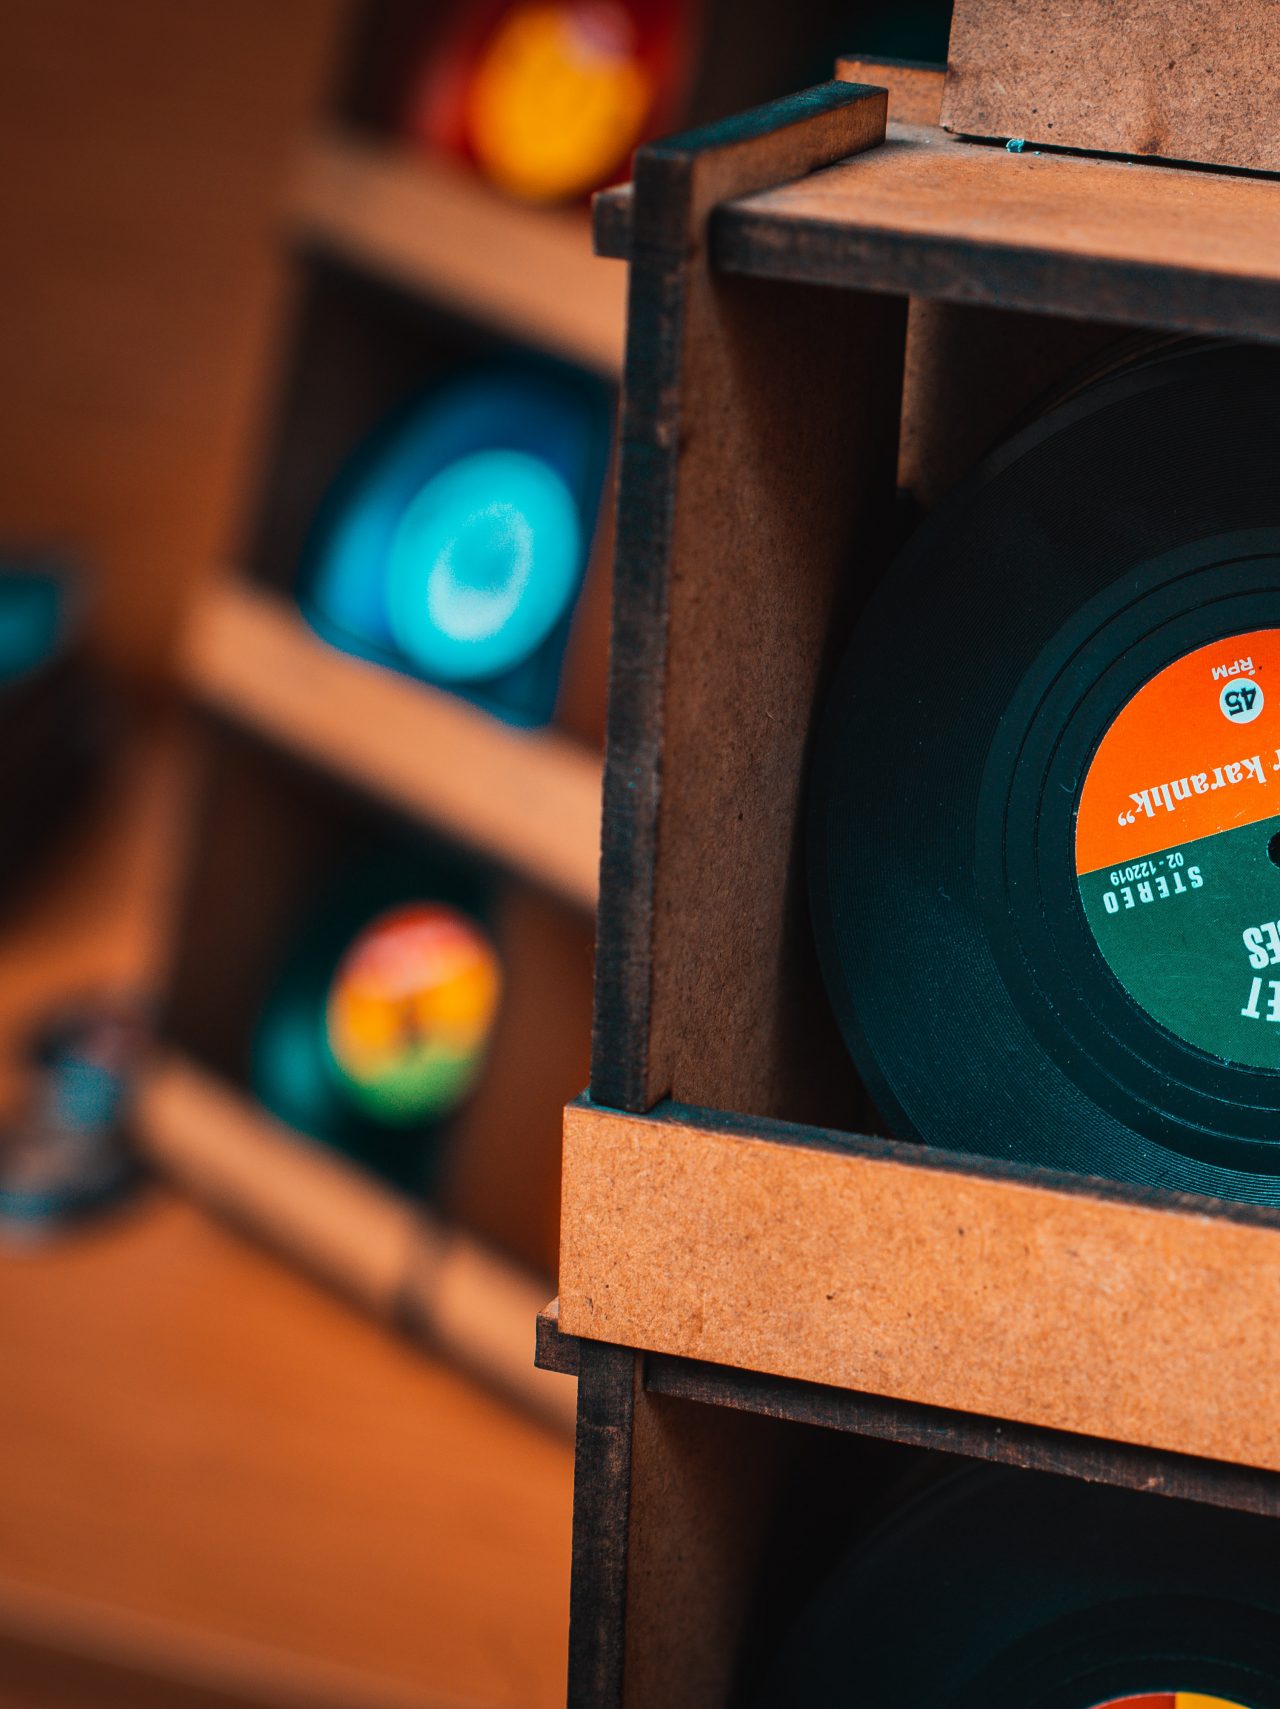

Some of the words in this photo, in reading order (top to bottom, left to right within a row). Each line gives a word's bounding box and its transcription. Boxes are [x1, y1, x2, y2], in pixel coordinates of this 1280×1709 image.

[1212, 656, 1254, 680] RPM
[1225, 687, 1257, 716] 45
[1167, 852, 1183, 866] 02
[1110, 861, 1156, 886] 122019
[1103, 866, 1203, 913] STEREO
